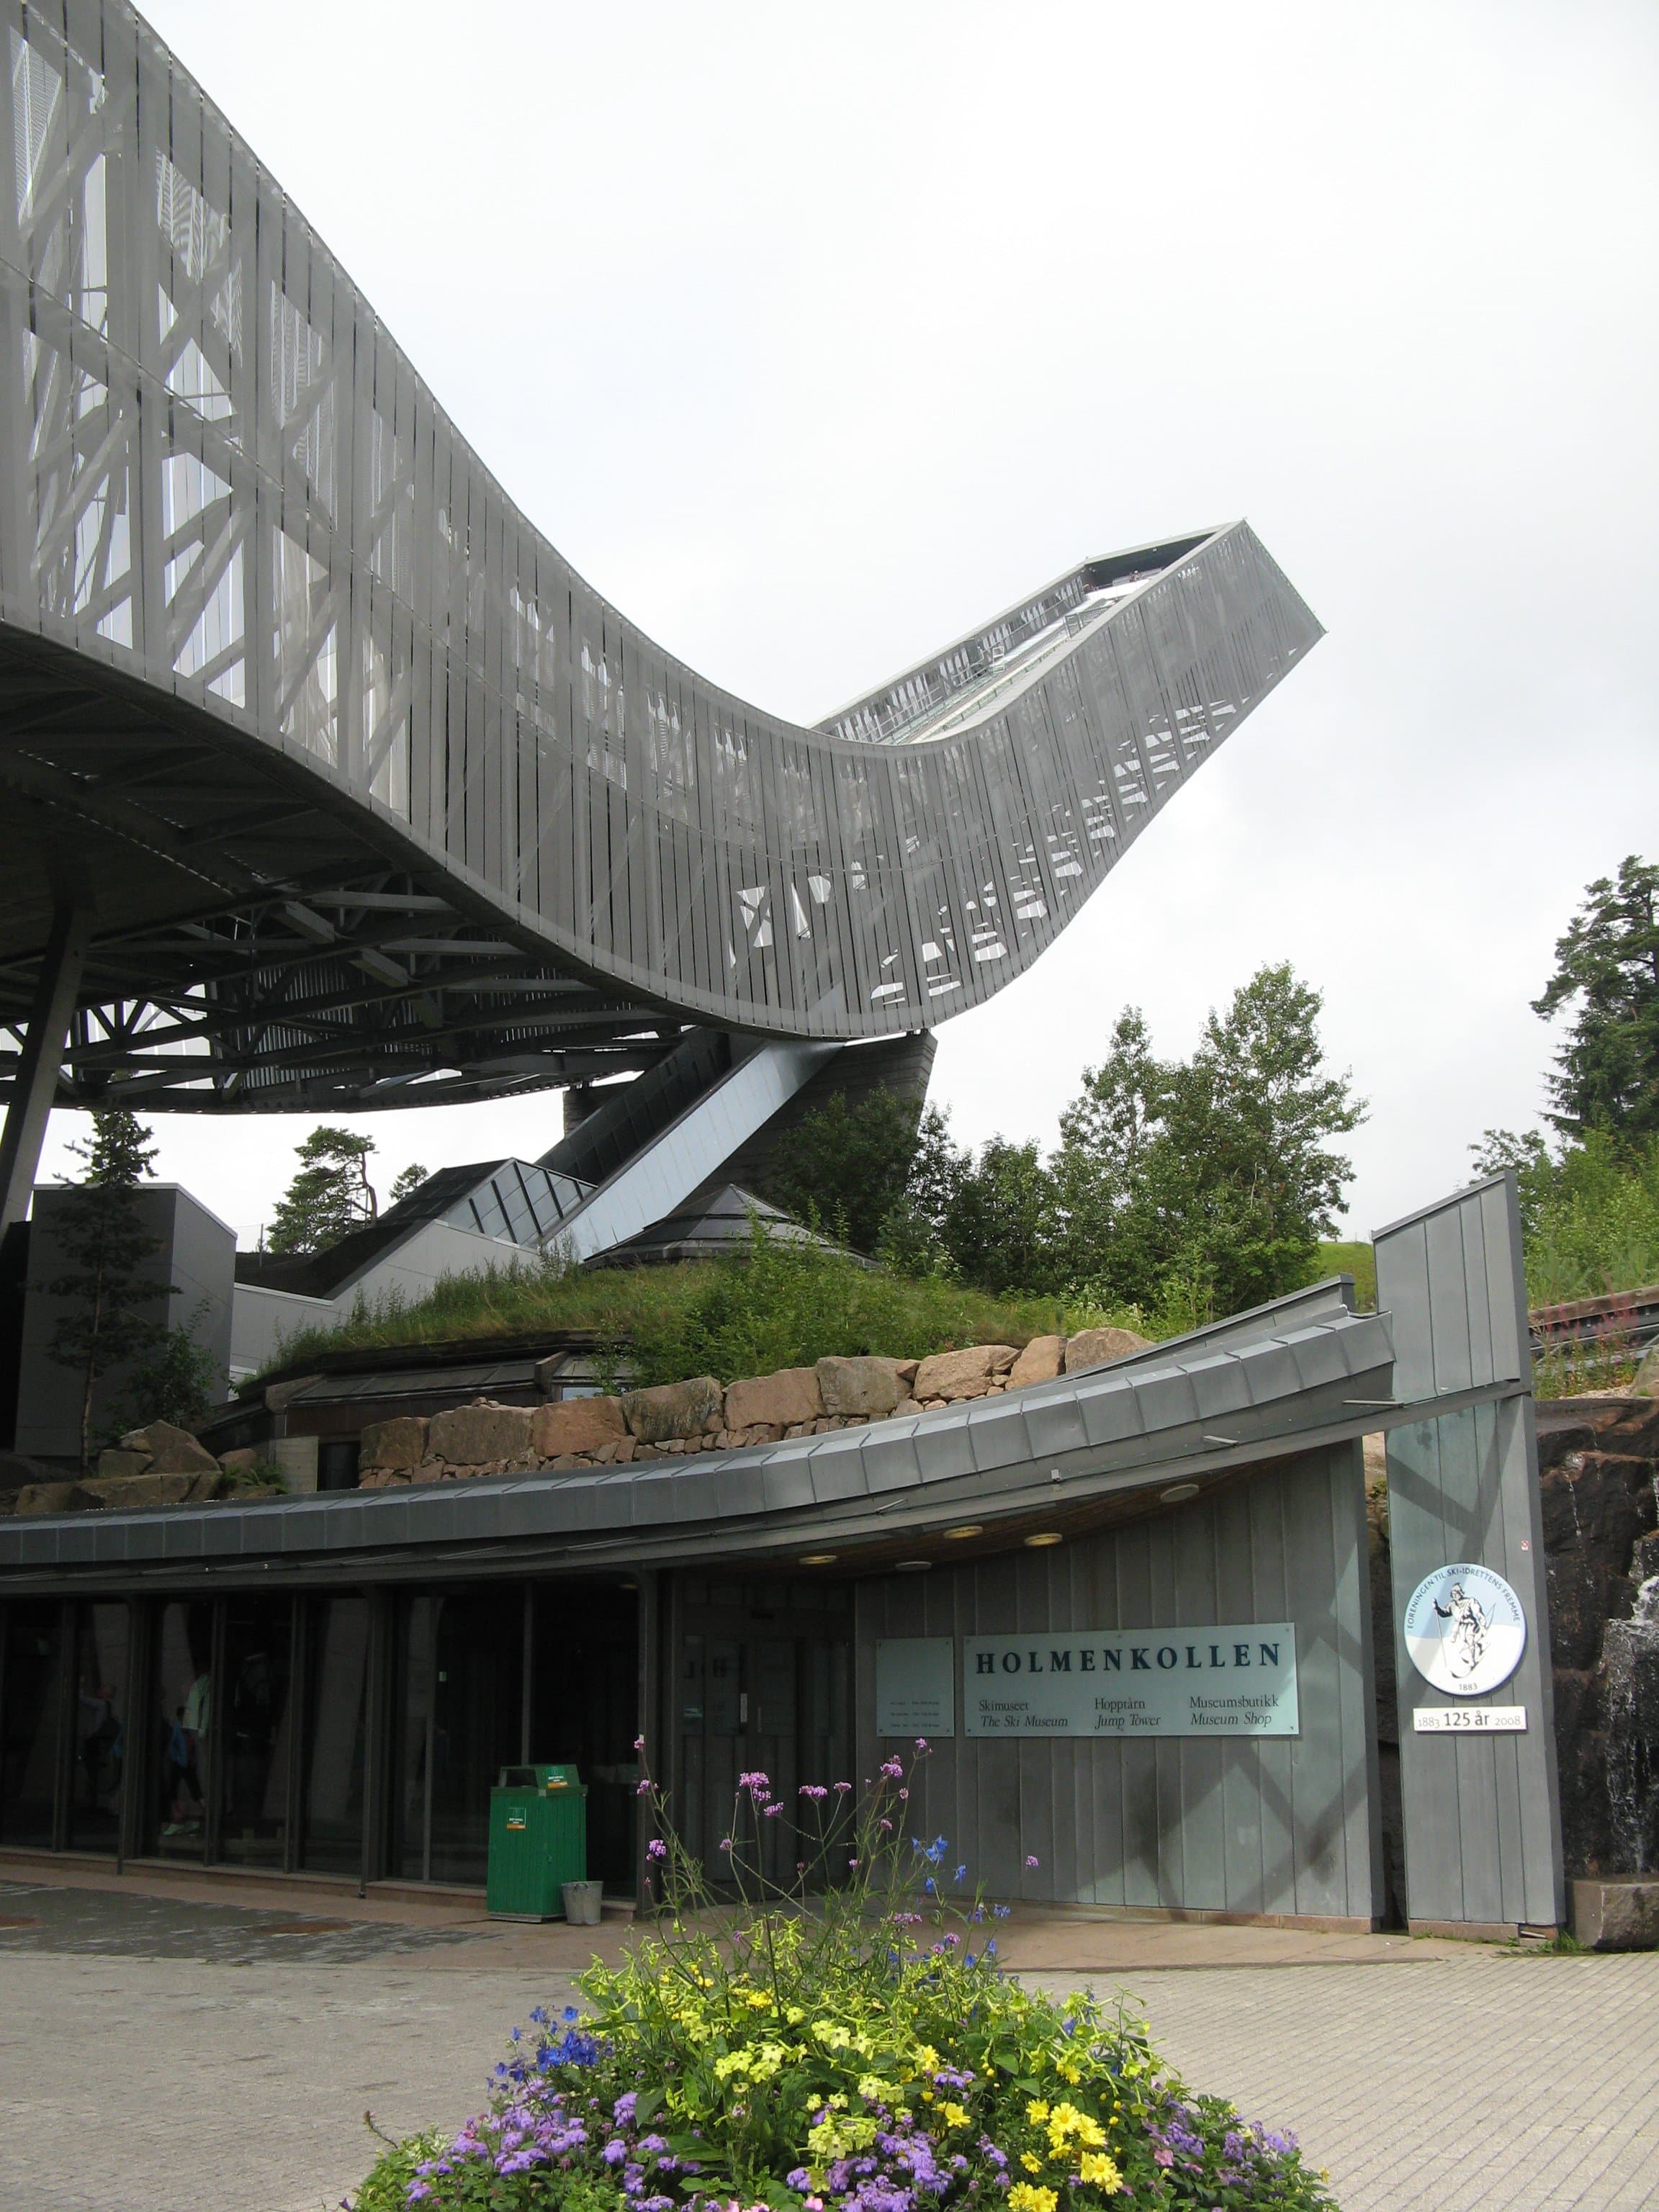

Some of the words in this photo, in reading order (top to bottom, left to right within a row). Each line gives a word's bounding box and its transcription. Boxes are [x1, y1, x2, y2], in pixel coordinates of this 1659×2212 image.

[1407, 1579, 1434, 1629] FORENINGEN
[1434, 1572, 1446, 1582] TIL
[1447, 1567, 1503, 1590] SKI-IDRETTENS
[1501, 1588, 1521, 1622] FREMME
[976, 1643, 1280, 1674] HOLMENKOLLEN
[1458, 1683, 1478, 1691] 1883
[979, 1699, 1030, 1712] Skimuseet
[1094, 1697, 1146, 1713] Hopptårn
[1190, 1694, 1280, 1709] Museumsbutikk
[981, 1715, 1001, 1727] The
[1004, 1714, 1020, 1727] Ski
[1025, 1714, 1069, 1727] Museum
[1094, 1714, 1125, 1730] Jump
[1130, 1714, 1161, 1727] Tower
[1190, 1712, 1238, 1726] Museum
[1244, 1711, 1272, 1728] Shop
[1418, 1717, 1440, 1729] 1883
[1444, 1712, 1471, 1727] 125
[1475, 1710, 1490, 1727] år
[1494, 1715, 1521, 1726] 2008
